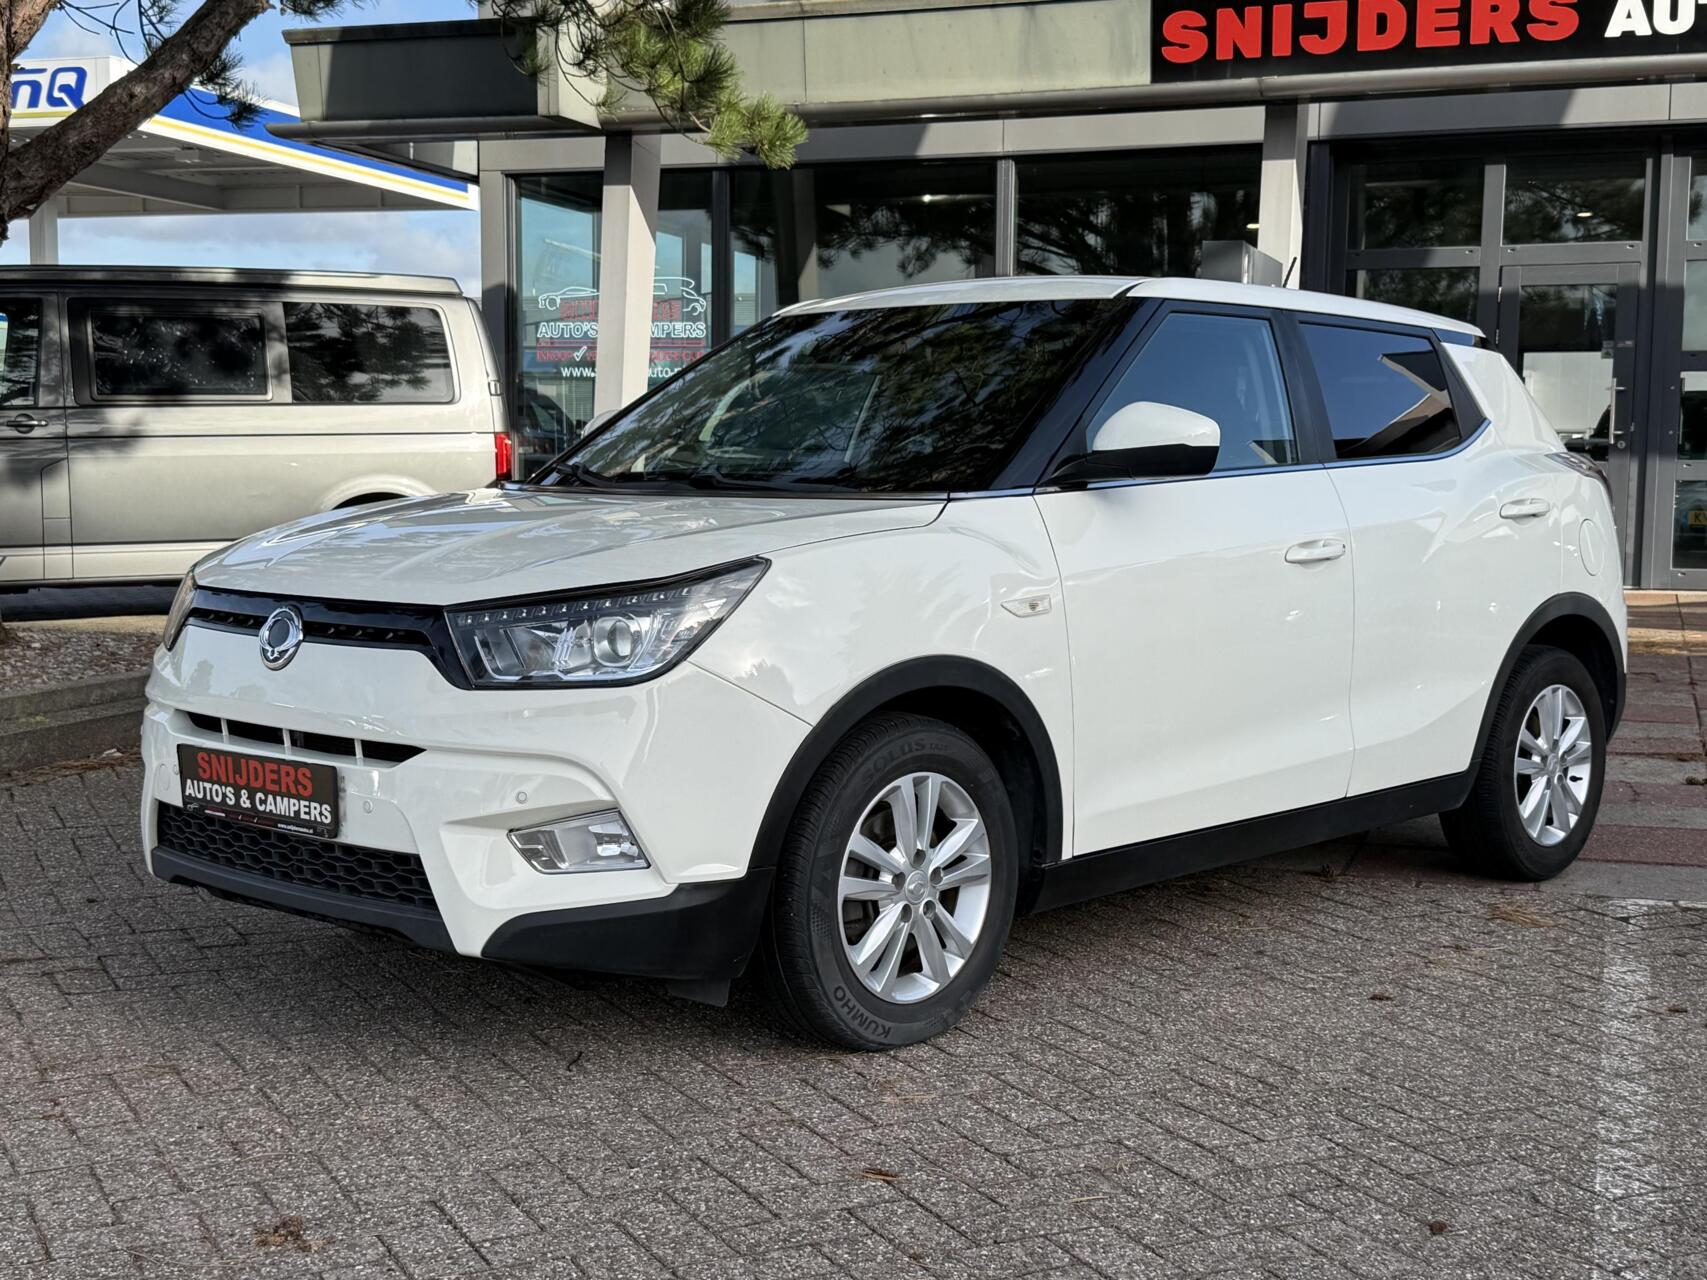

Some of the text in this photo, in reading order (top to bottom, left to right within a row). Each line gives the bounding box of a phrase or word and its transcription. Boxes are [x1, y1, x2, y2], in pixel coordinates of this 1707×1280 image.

[1161, 0, 1707, 63] SNIJDERS AU
[11, 66, 88, 109] nQ
[537, 321, 707, 338] AUTO'S MPERS
[560, 367, 598, 378] www.
[197, 751, 313, 797] SNIJDERS
[185, 778, 236, 805] AUTO'S
[240, 789, 252, 809] &
[255, 792, 332, 824] CAMPERS
[833, 985, 892, 1038] KUMHO
